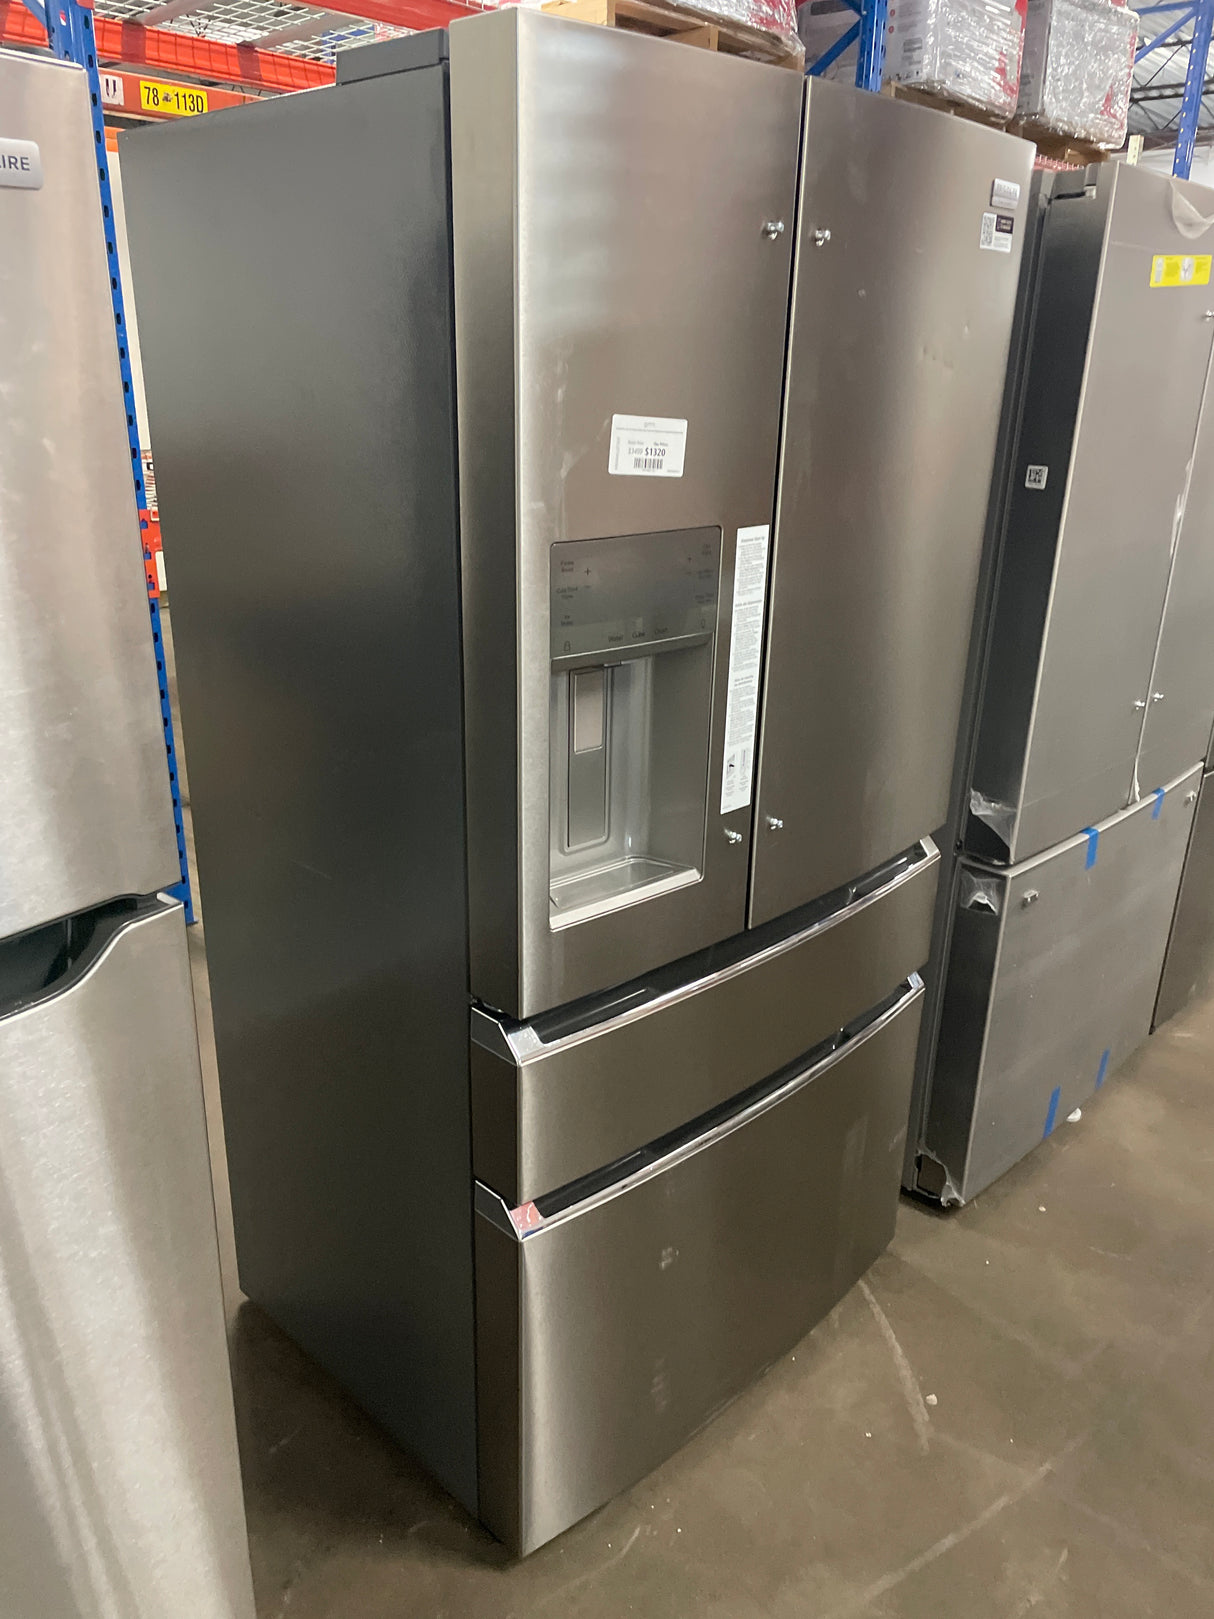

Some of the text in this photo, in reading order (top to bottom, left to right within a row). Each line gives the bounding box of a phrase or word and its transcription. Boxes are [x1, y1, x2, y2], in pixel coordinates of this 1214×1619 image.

[144, 86, 204, 113] 78 113D
[0, 154, 31, 171] IRE
[644, 446, 666, 457] $1320
